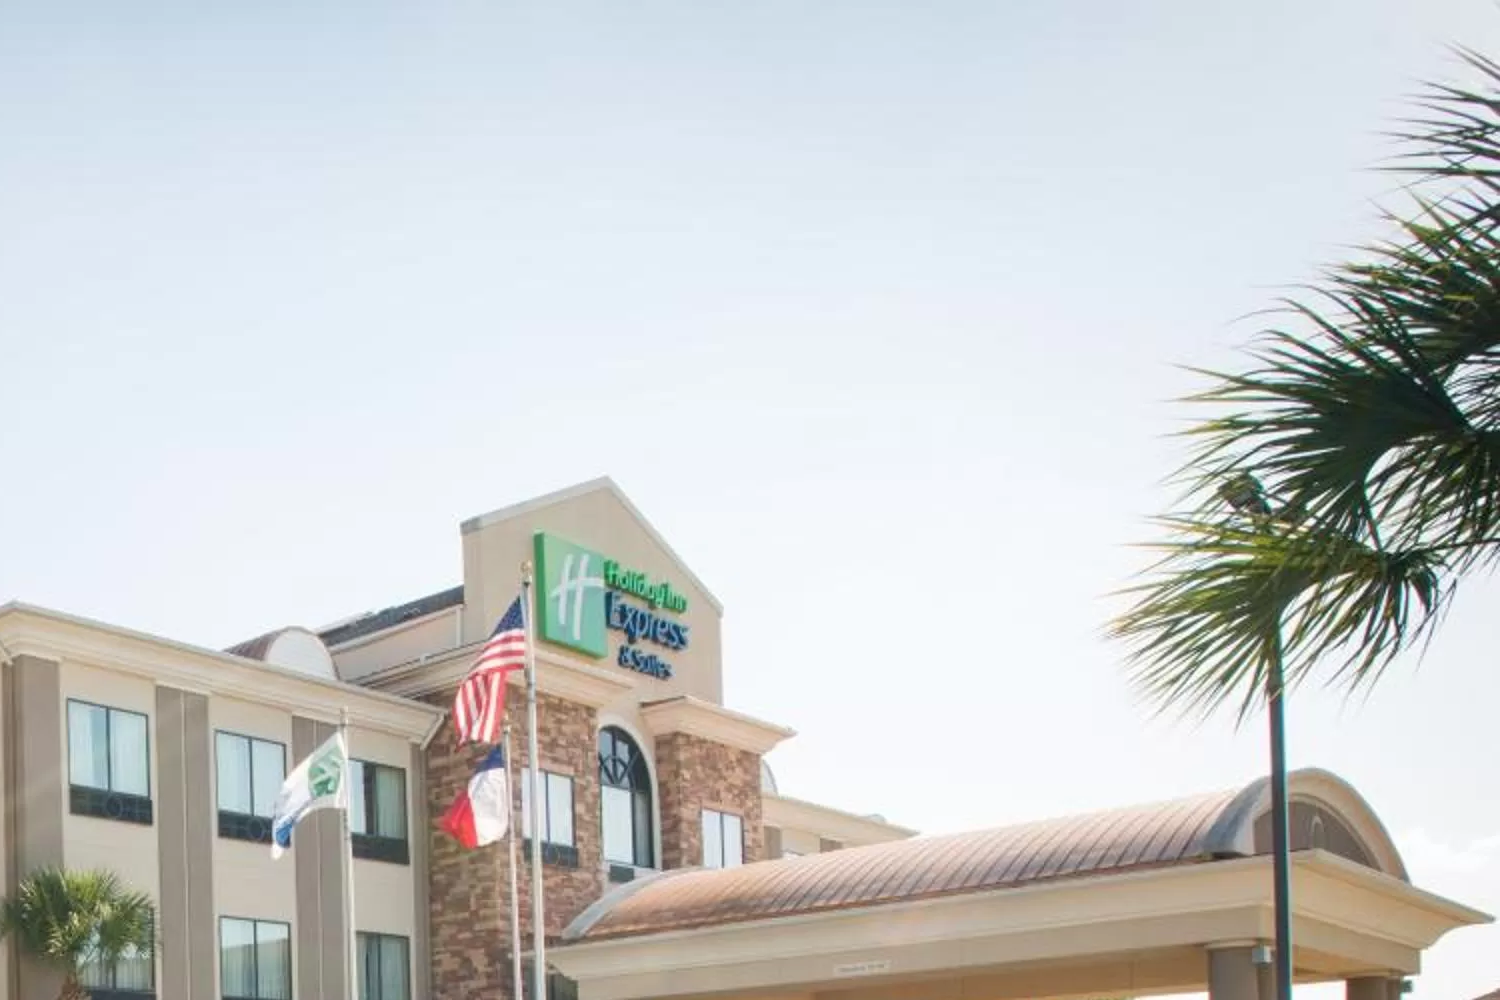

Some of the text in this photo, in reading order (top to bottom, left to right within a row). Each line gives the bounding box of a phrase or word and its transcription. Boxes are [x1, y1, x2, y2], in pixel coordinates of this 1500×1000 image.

[604, 560, 687, 613] Holiday Inn
[605, 591, 690, 651] Express
[630, 648, 674, 680] Suites
